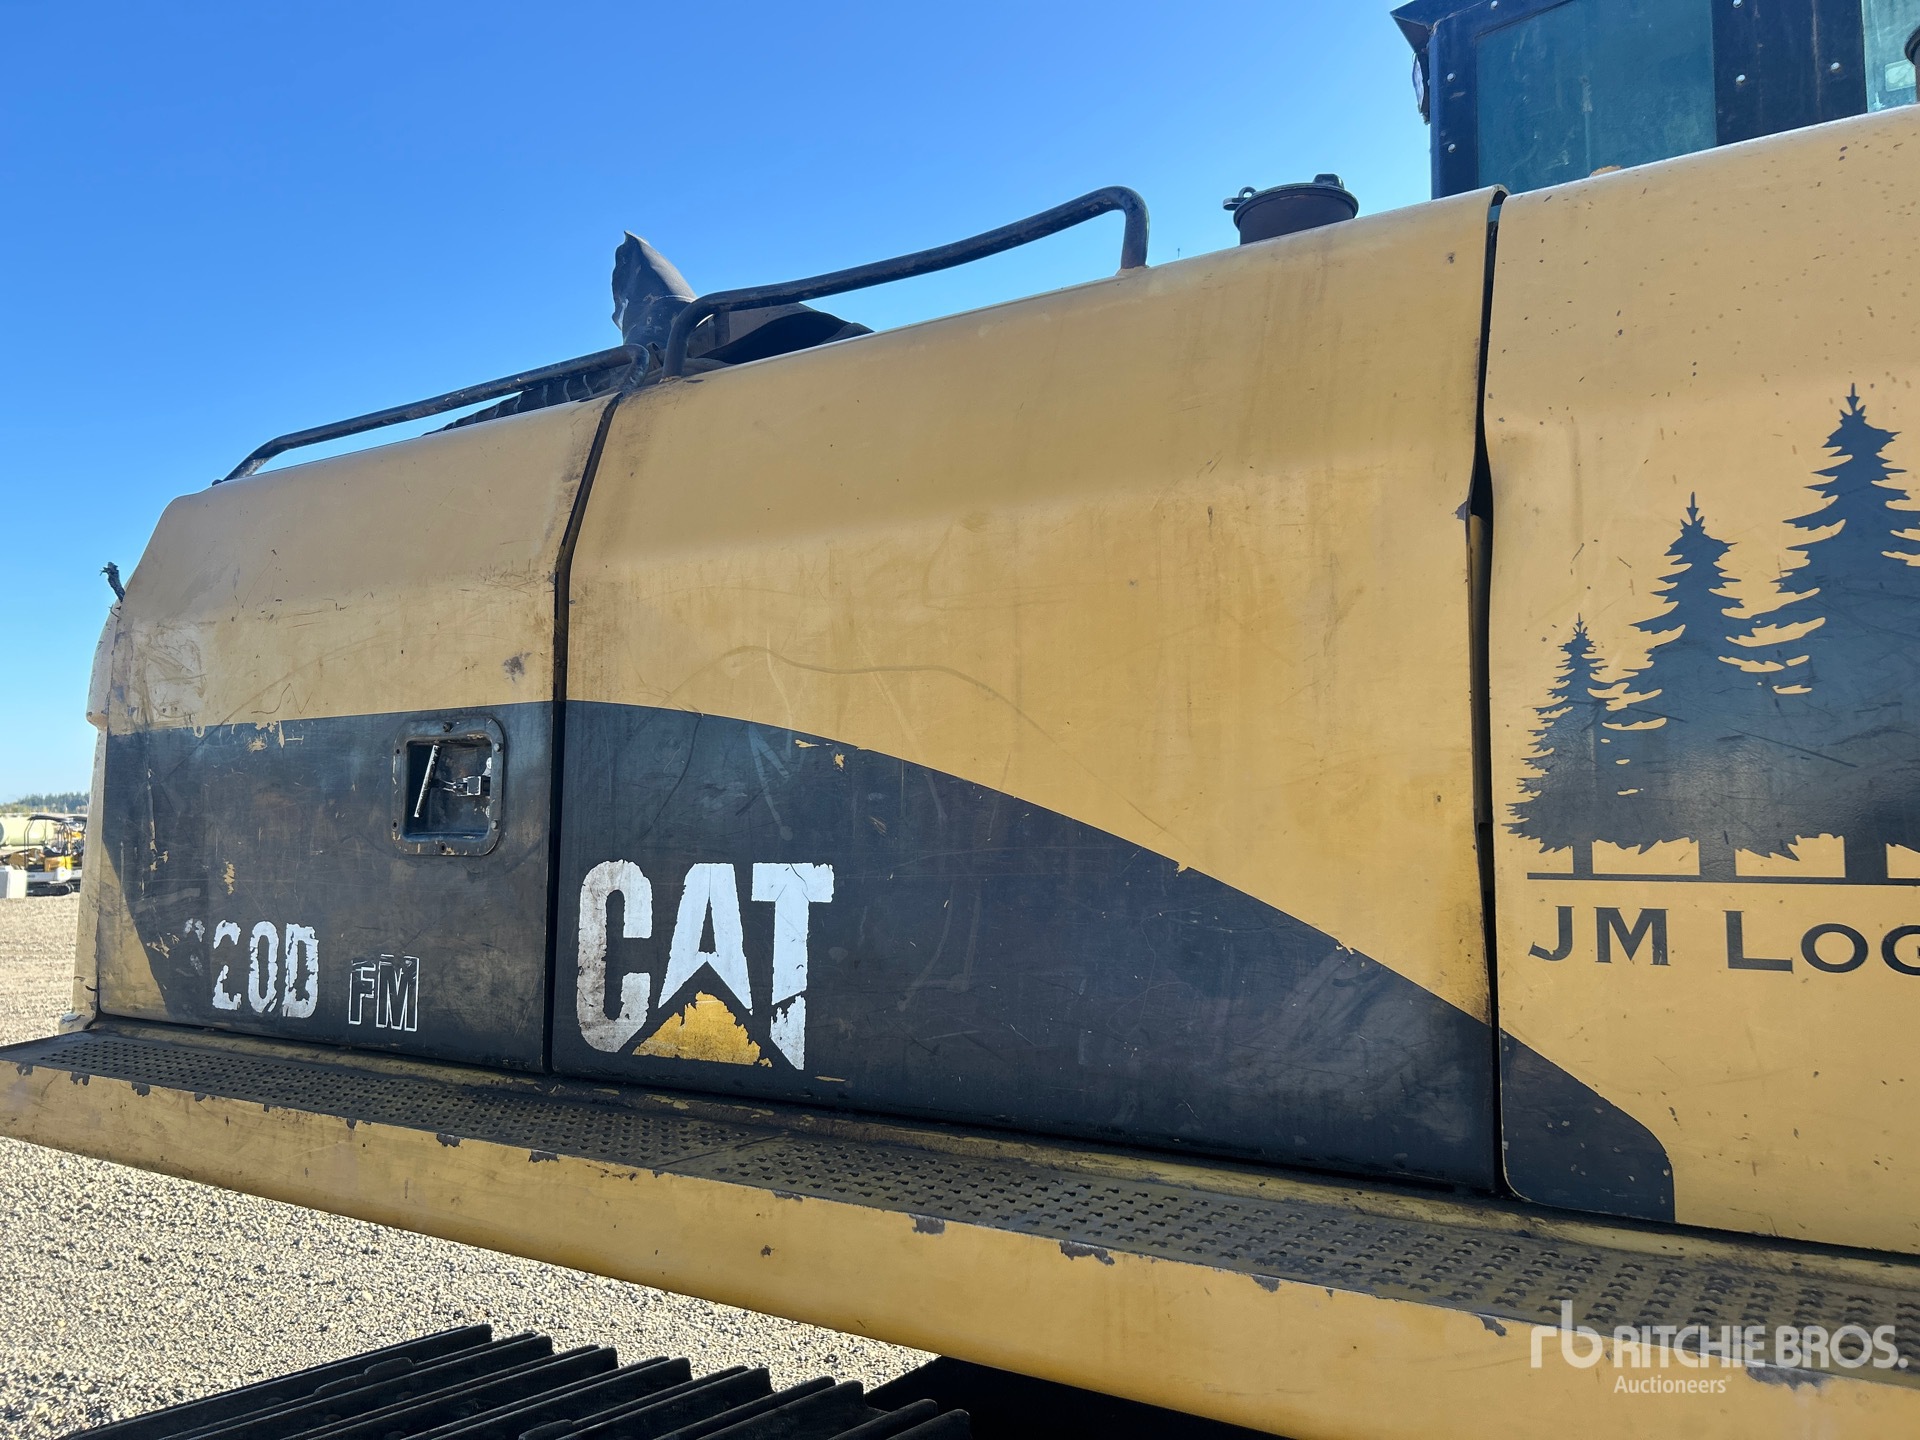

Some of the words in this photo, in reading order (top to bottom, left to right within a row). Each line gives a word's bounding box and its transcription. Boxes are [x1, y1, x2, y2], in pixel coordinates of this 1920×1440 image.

[576, 859, 834, 1070] CAT
[1528, 905, 1670, 966] JM
[348, 954, 420, 1032] FM
